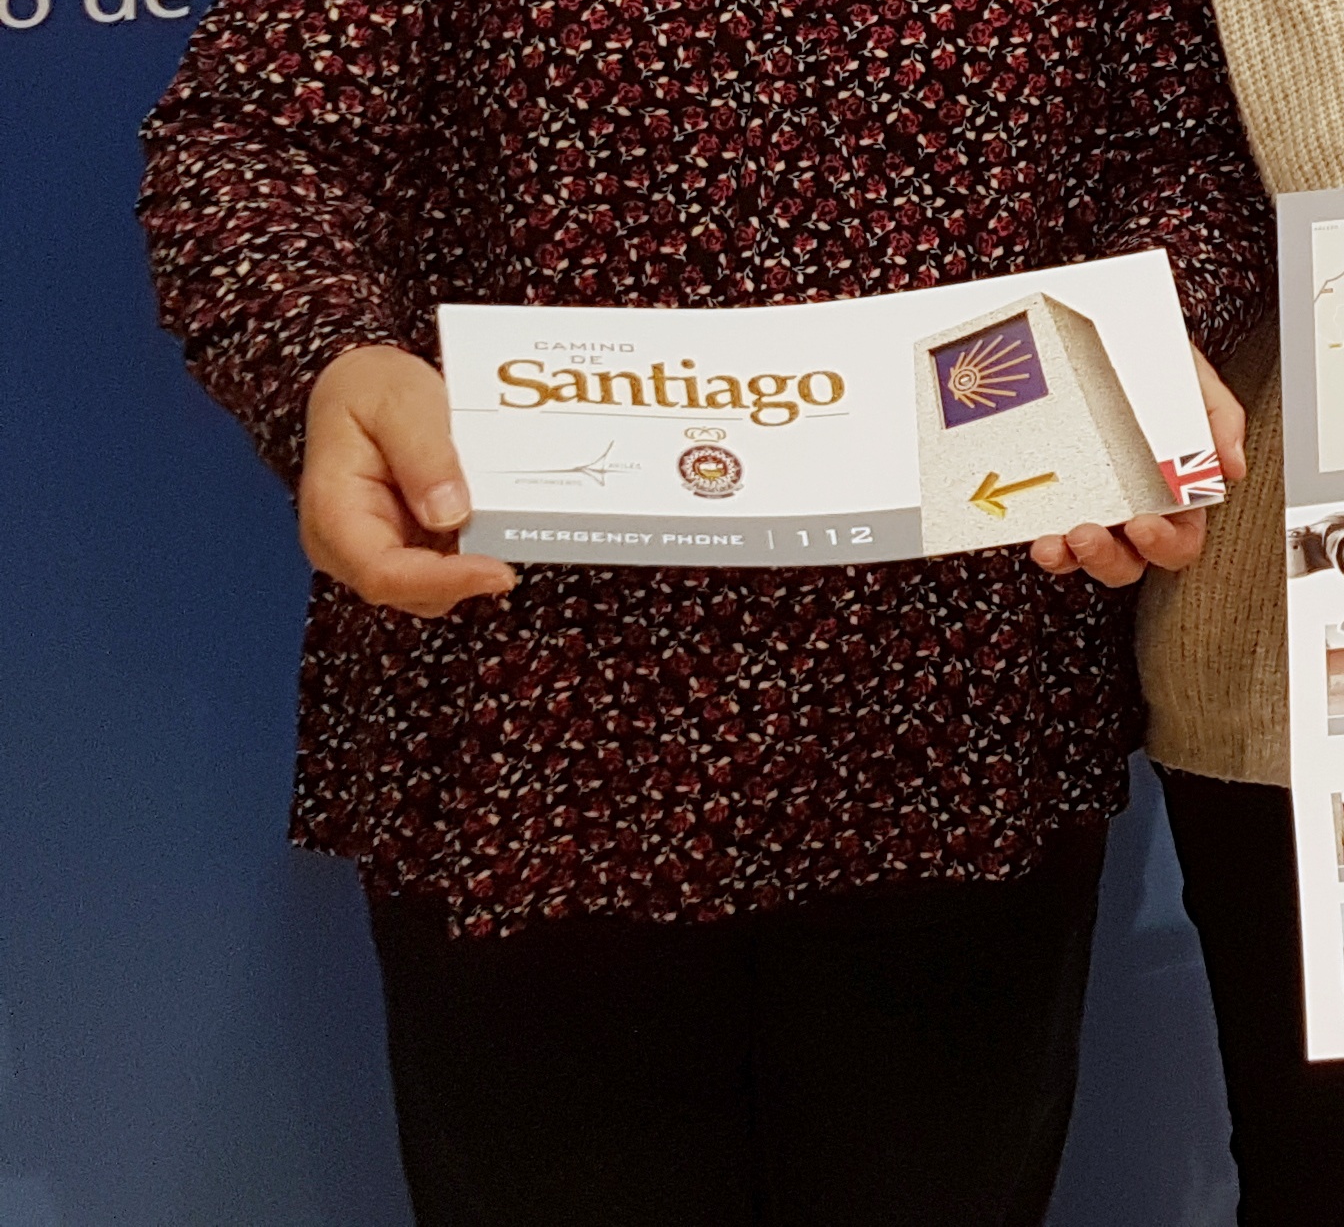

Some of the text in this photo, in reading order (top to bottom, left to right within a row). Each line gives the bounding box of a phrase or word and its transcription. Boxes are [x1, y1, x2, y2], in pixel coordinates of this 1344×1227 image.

[534, 341, 635, 353] CAMINO
[571, 355, 603, 365] DE
[497, 358, 846, 427] Santiago
[504, 526, 873, 546] EMERGENCY PHONE 112
